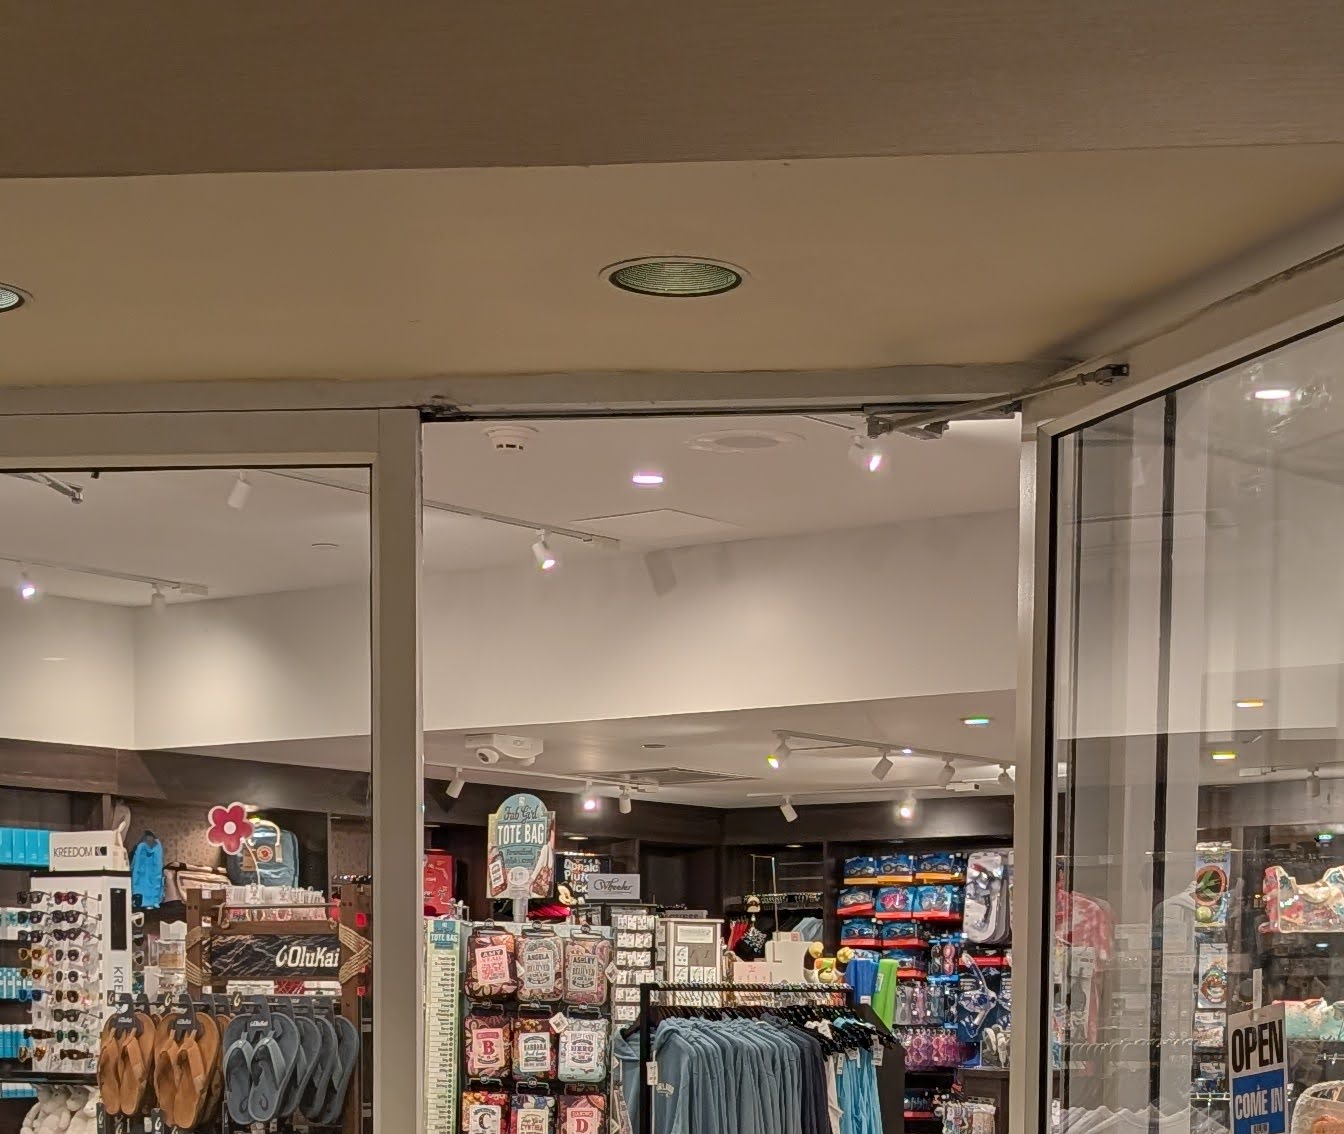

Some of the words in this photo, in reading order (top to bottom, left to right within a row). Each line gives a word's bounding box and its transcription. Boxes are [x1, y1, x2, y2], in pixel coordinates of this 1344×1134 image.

[498, 824, 522, 845] TOTE
[524, 823, 545, 845] BAG
[53, 847, 93, 858] KREEDOM
[593, 878, 633, 892] Wheeler
[287, 946, 341, 968] OluKai
[482, 1040, 495, 1056] B
[1232, 1019, 1284, 1073] OPEN
[1235, 1090, 1268, 1120] COME
[1270, 1087, 1284, 1114] IN
[478, 1112, 492, 1130] C
[575, 1118, 589, 1134] D
